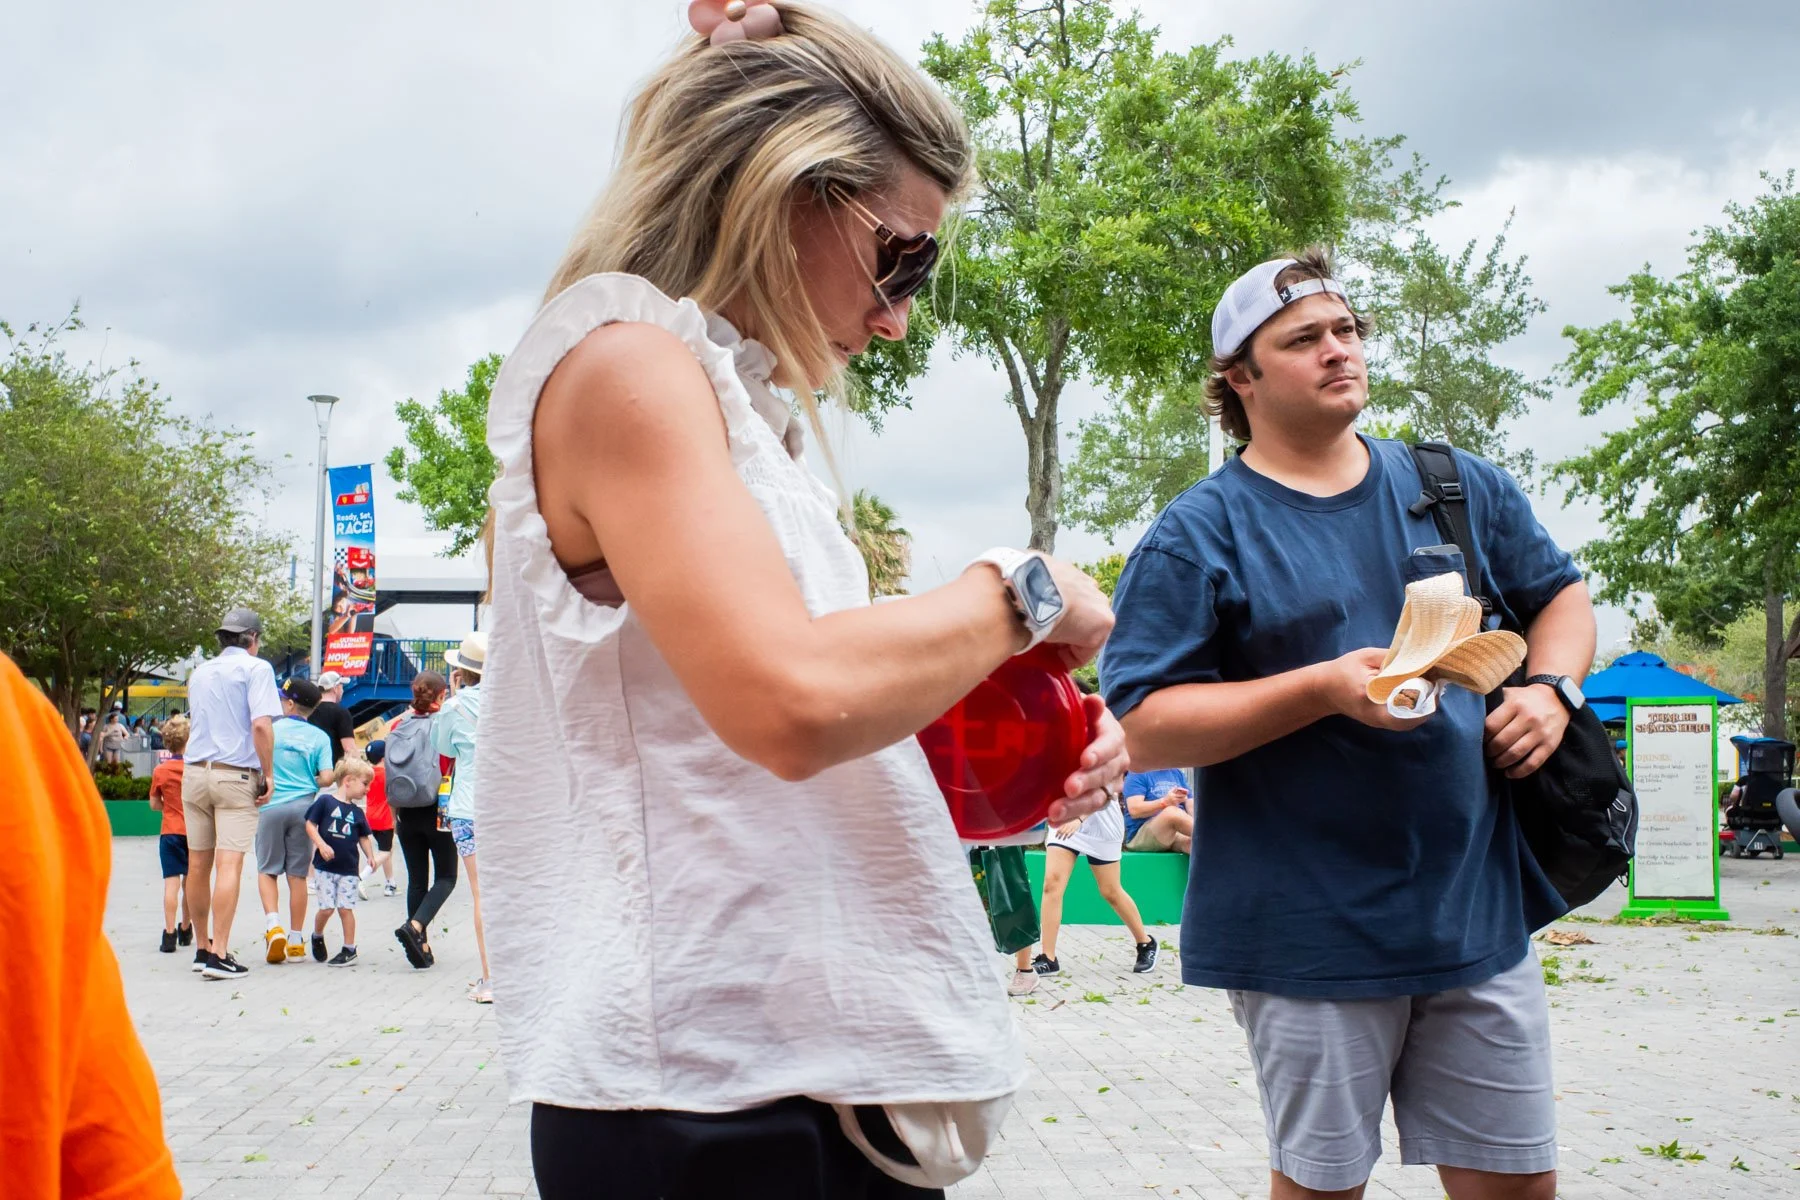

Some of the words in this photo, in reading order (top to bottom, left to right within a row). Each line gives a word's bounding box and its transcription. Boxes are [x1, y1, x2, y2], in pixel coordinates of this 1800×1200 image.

[336, 513, 359, 522] Ready,
[360, 512, 373, 520] Set,
[336, 521, 373, 535] RACE!
[327, 653, 350, 662] NOW
[343, 660, 367, 669] OPEN
[1680, 713, 1697, 721] BE
[1635, 723, 1677, 733] SNACKS
[1678, 724, 1710, 733] HERE
